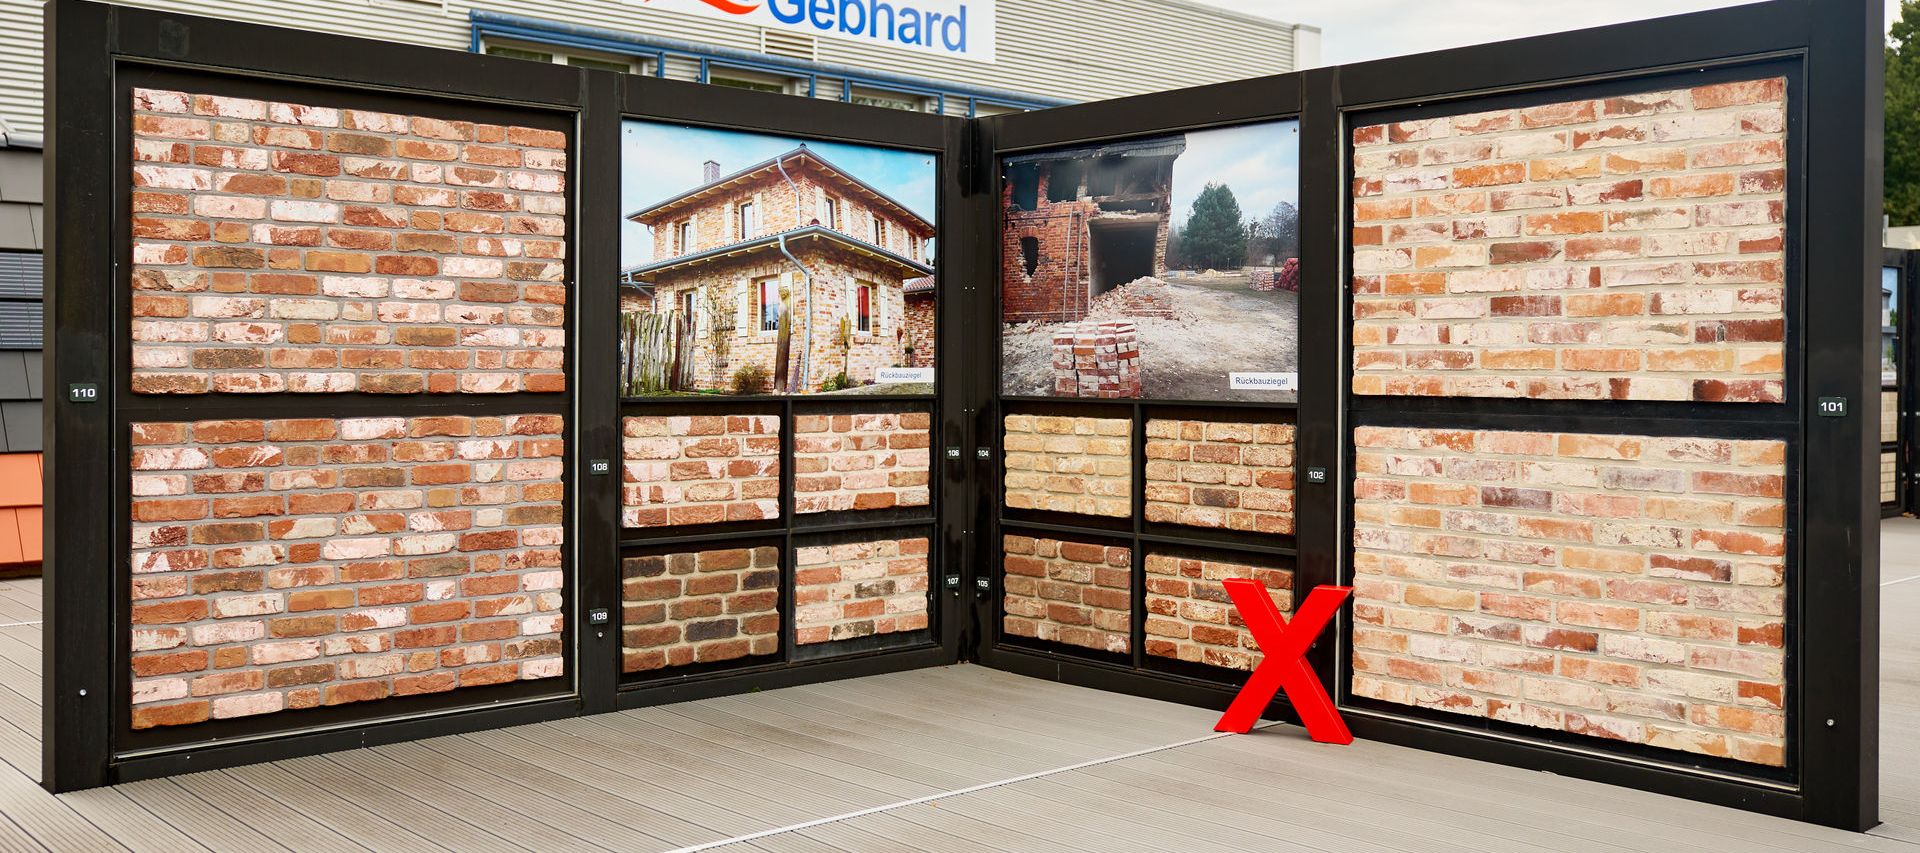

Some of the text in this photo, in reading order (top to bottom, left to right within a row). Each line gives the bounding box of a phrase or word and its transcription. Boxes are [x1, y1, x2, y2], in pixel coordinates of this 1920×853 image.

[881, 371, 922, 380] Rückbauziegel
[1235, 376, 1288, 387] Rückbauziegel
[72, 388, 96, 398] 110
[1821, 401, 1843, 412] 101
[592, 463, 608, 471] 108
[1308, 471, 1324, 480] 102
[947, 577, 959, 585] 107
[977, 579, 989, 588] 105
[591, 611, 608, 621] 109
